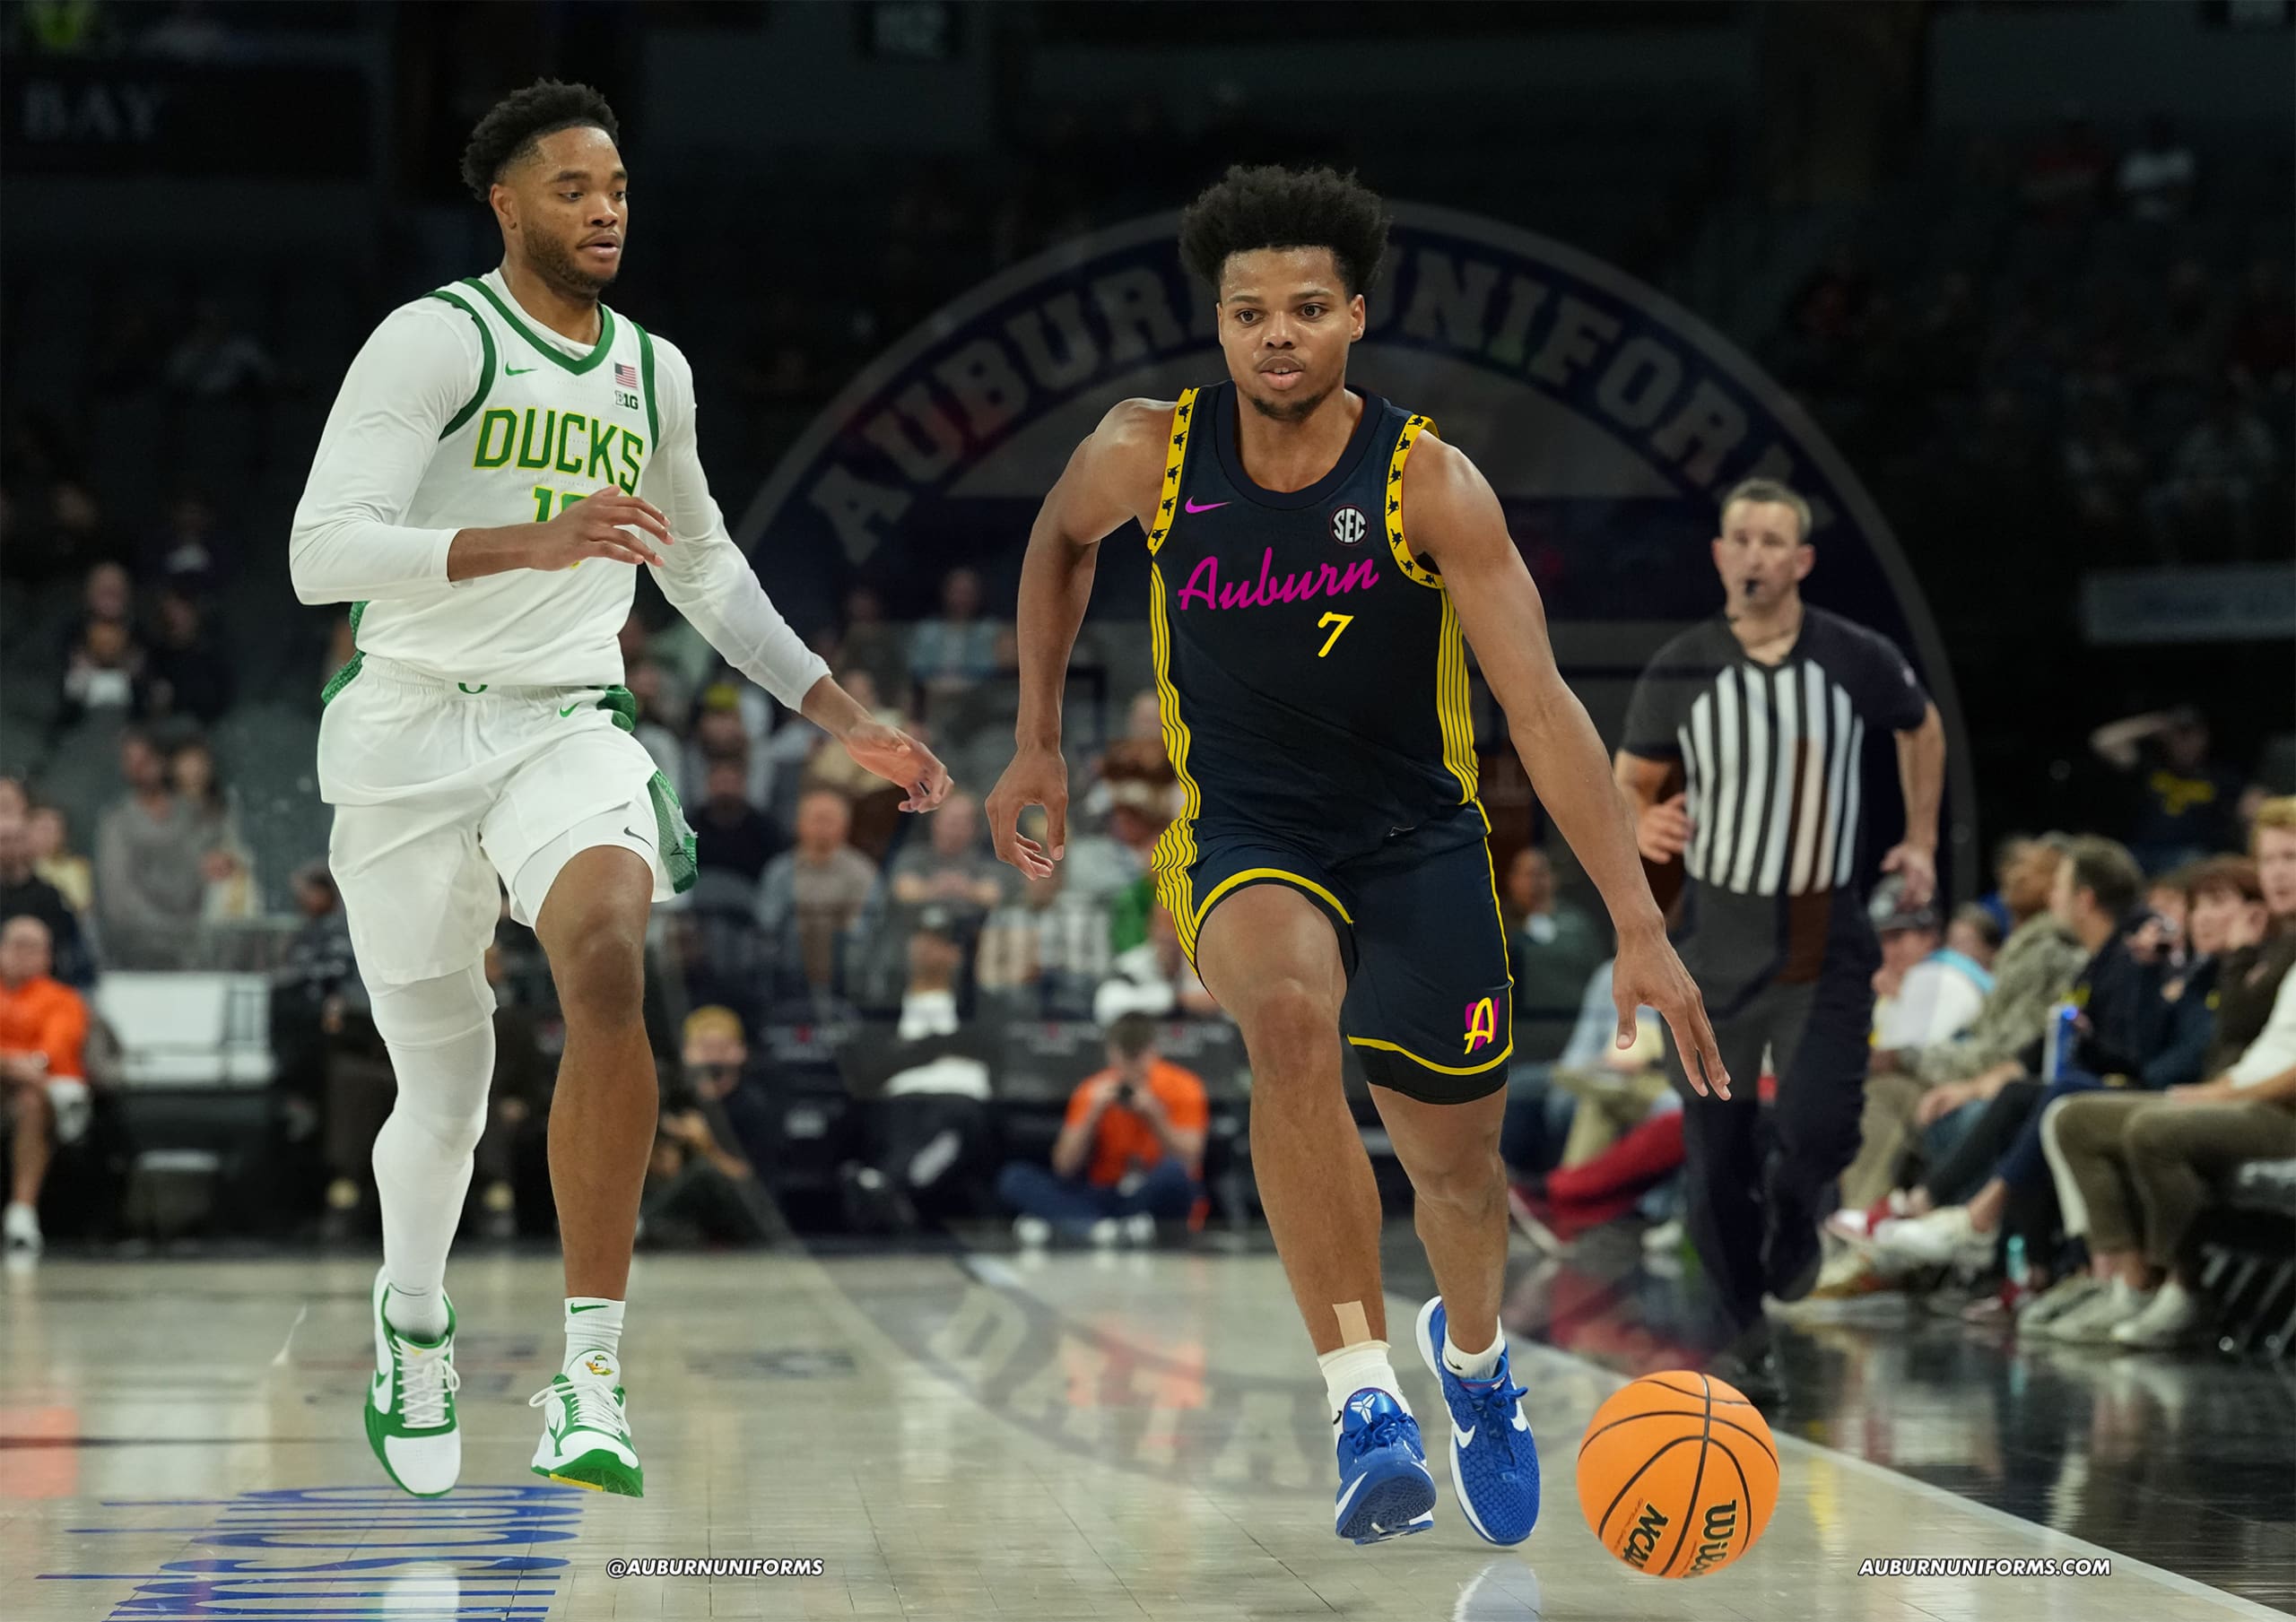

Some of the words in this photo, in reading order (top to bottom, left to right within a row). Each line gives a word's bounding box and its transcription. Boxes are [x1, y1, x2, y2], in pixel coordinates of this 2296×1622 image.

[473, 407, 644, 498] DUCKS
[1333, 507, 1366, 543] SEC
[1178, 546, 1379, 611] Auburn
[1318, 612, 1354, 657] 7
